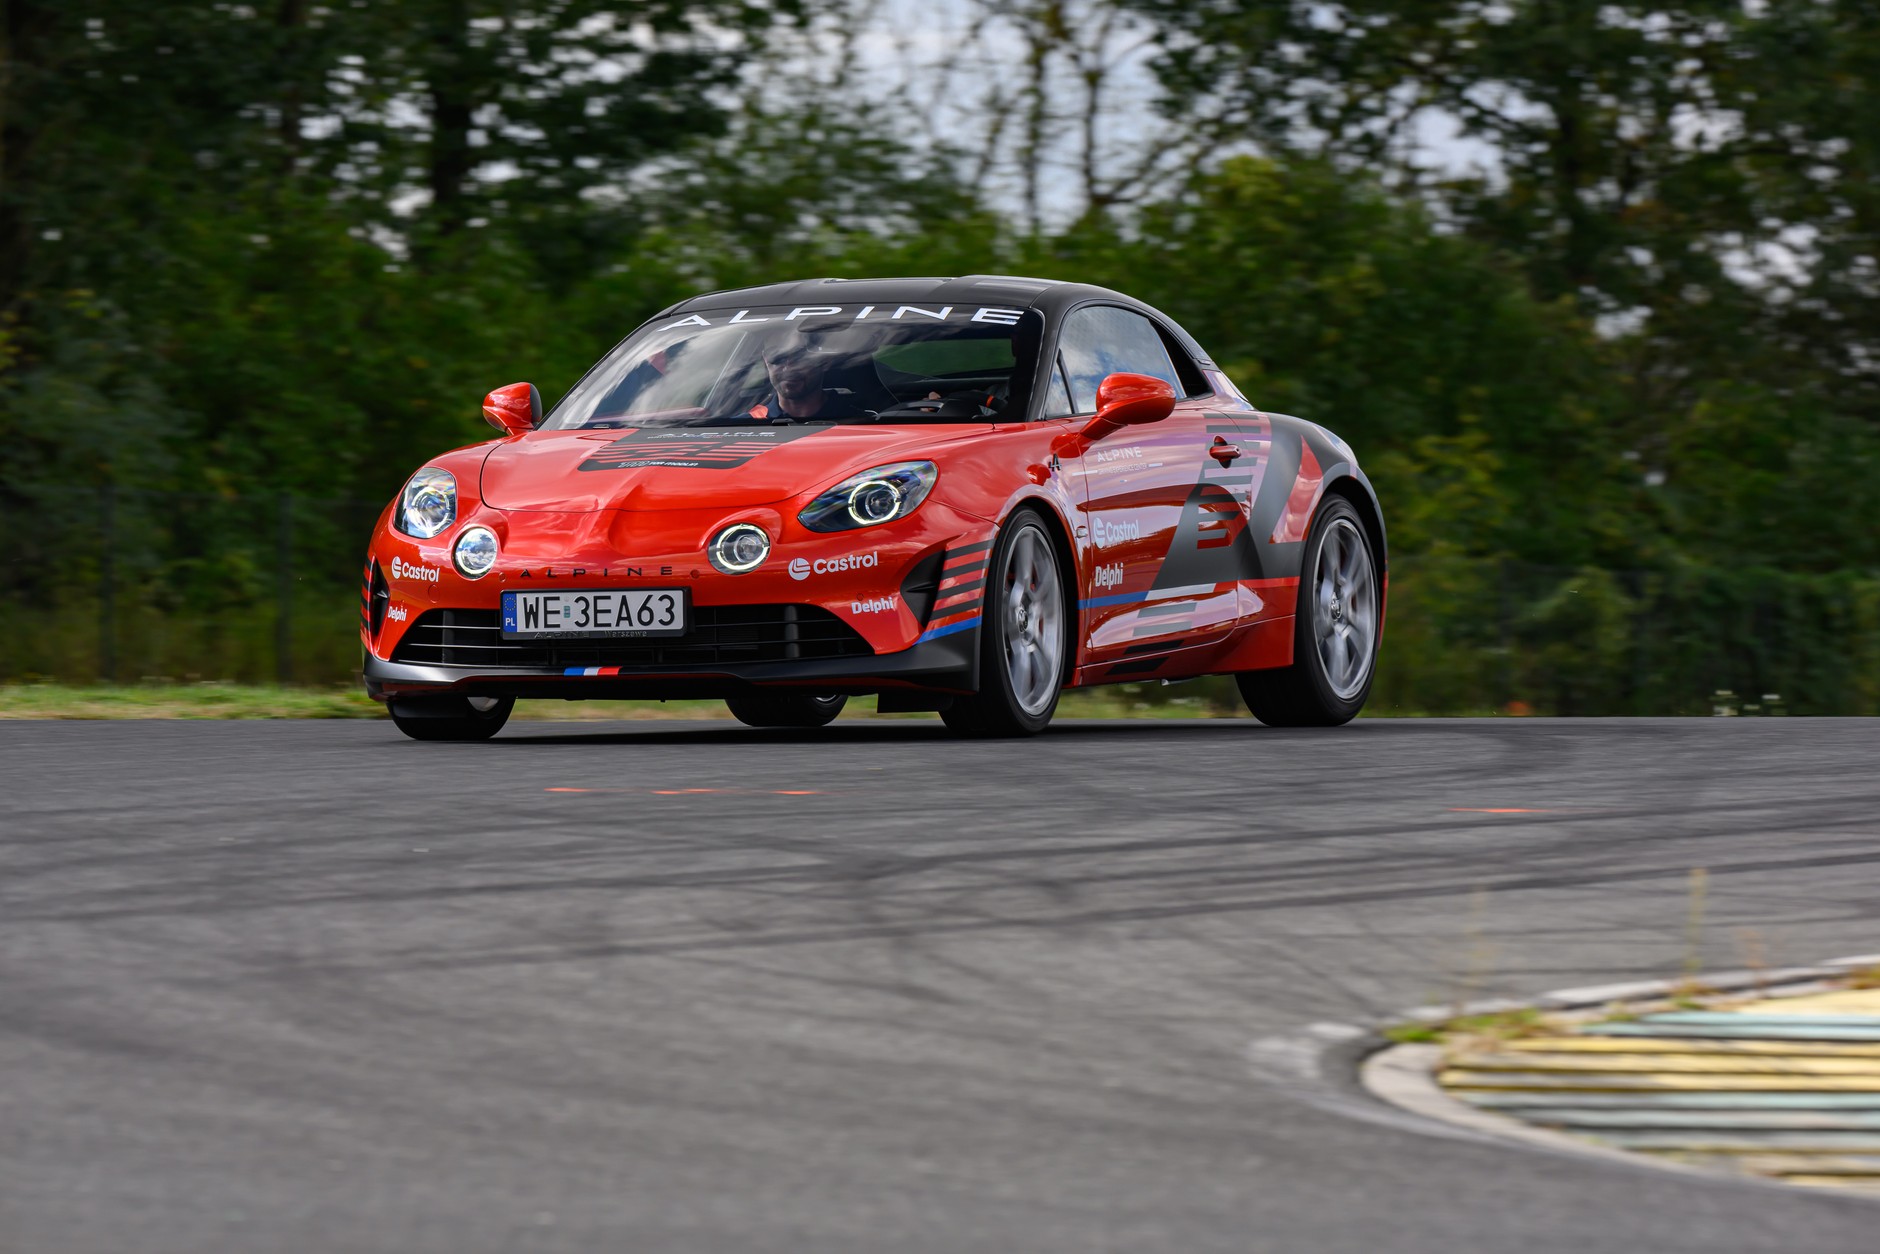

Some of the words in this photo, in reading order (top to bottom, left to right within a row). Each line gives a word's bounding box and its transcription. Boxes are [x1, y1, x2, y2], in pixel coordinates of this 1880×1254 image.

[656, 305, 1025, 332] ALPINE
[1097, 446, 1143, 462] ALPINE
[1105, 519, 1140, 542] Castrol
[401, 562, 440, 583] Castrol
[520, 566, 673, 578] ALPINE
[813, 551, 878, 575] Castrol
[1095, 562, 1124, 590] Delphi
[388, 605, 408, 622] Delphi
[523, 596, 561, 629] WE
[574, 594, 676, 628] 3EA63
[851, 596, 894, 614] Delphi
[505, 617, 516, 627] PL
